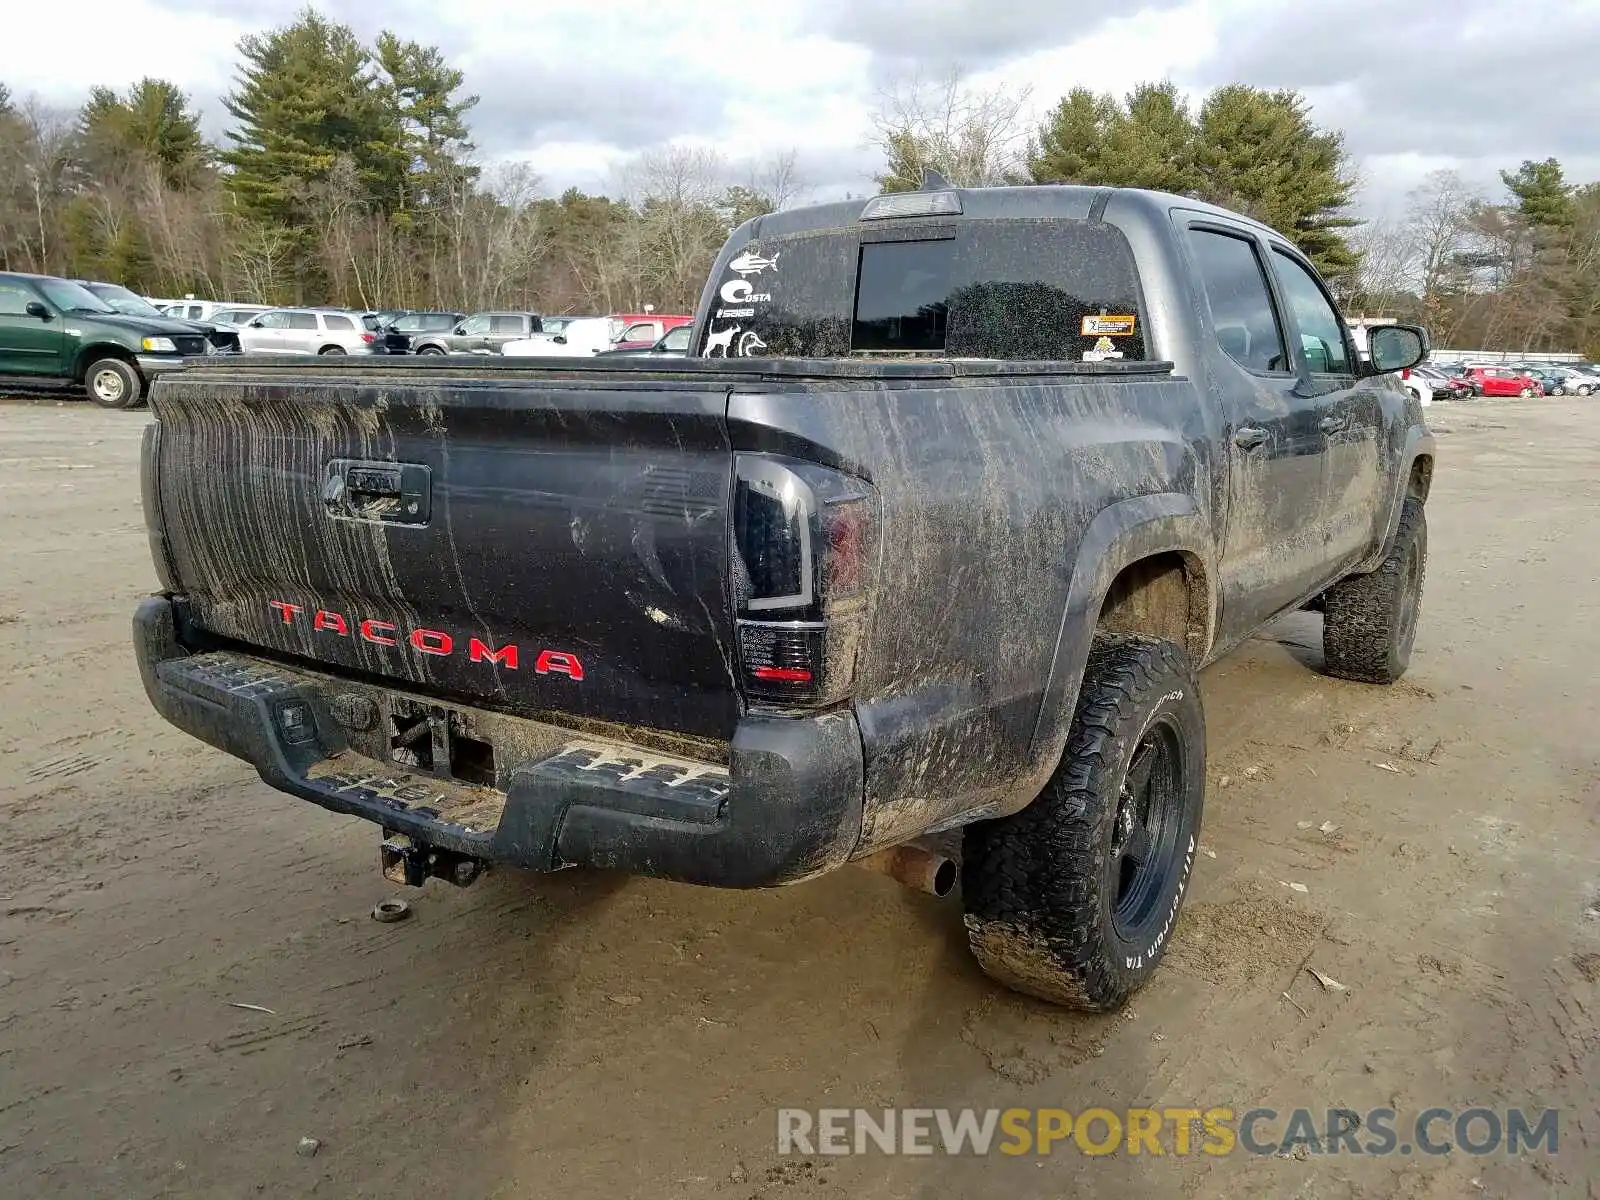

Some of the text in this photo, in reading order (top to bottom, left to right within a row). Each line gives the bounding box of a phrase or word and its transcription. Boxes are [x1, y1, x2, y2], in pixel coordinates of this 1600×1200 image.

[720, 279, 771, 303] COSTA
[270, 599, 585, 681] TACOMA
[1126, 955, 1143, 970] T/A
